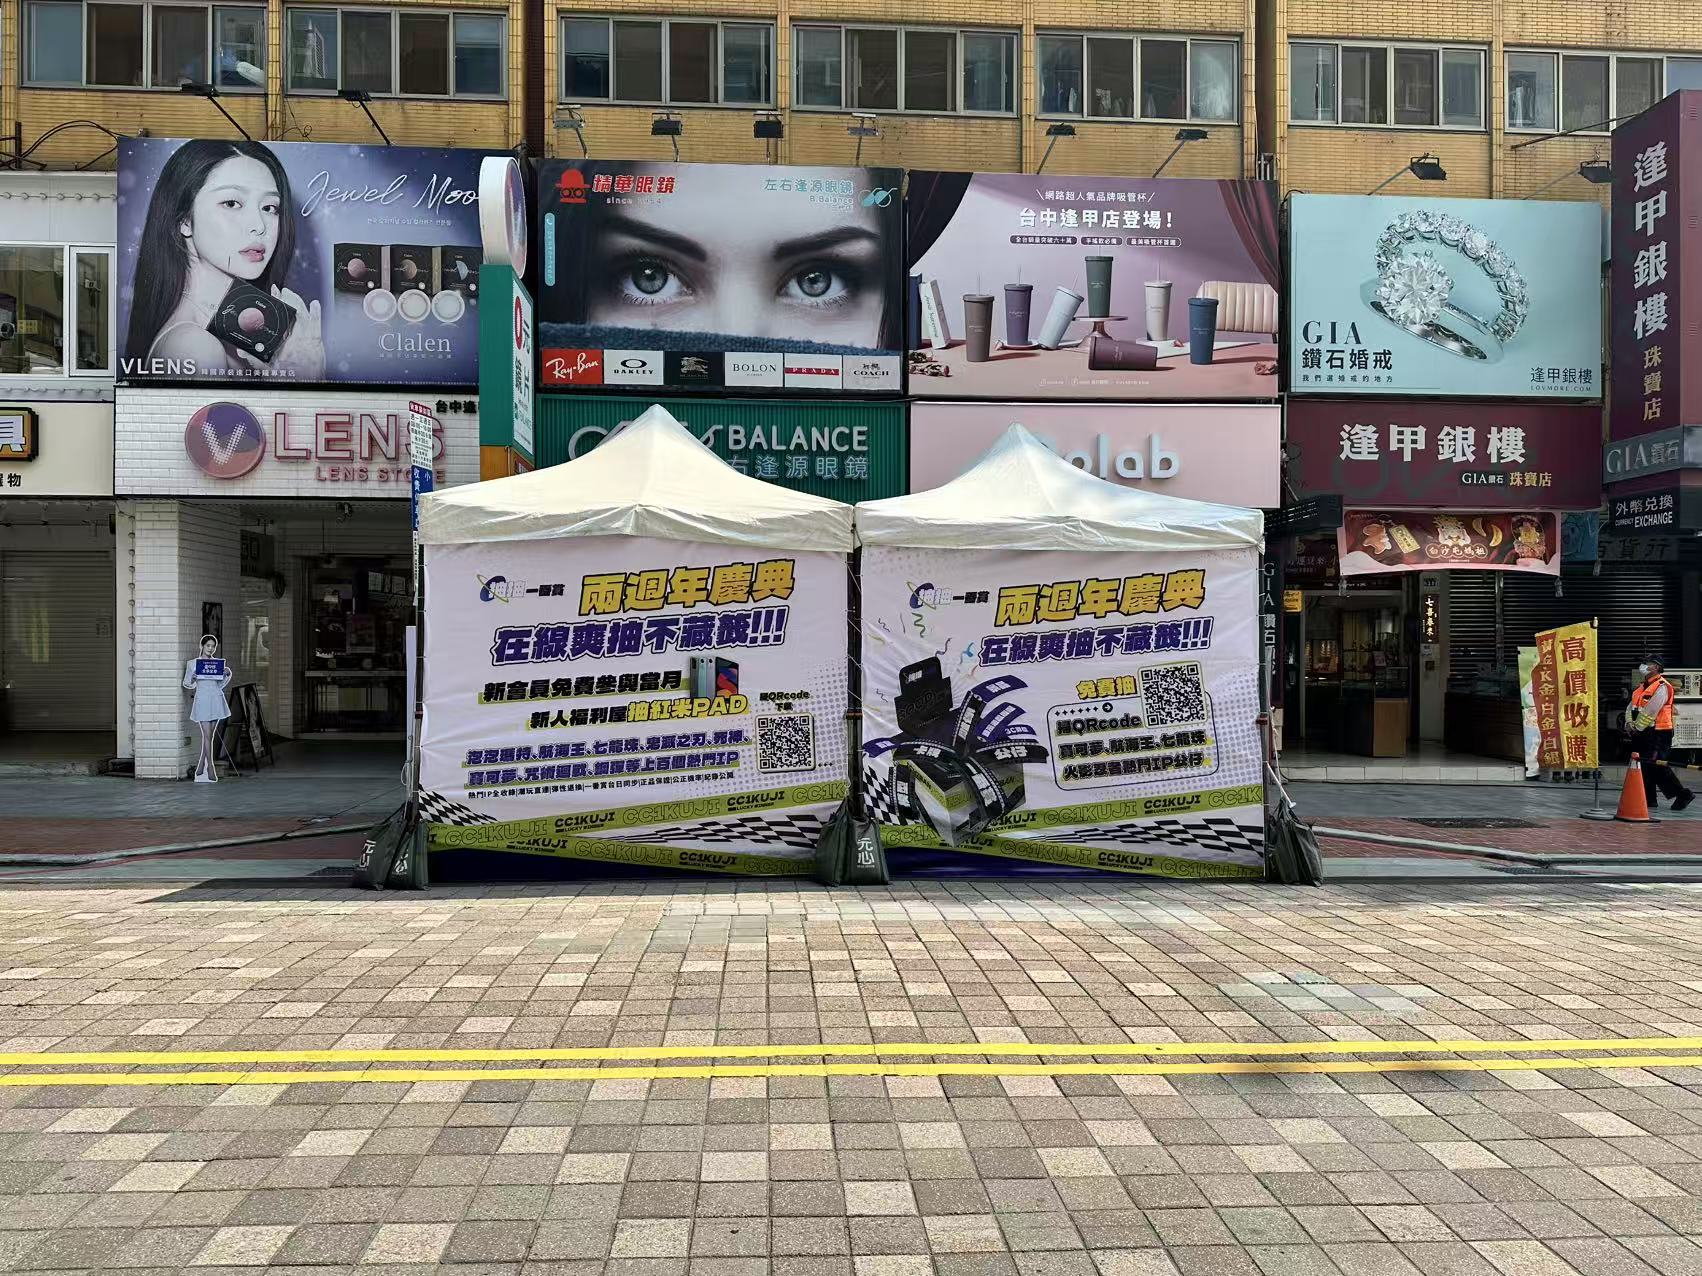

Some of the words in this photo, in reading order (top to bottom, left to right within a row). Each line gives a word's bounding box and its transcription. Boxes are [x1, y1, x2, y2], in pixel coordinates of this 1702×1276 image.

[301, 170, 407, 217] Jewel
[413, 173, 480, 215] Moo
[592, 174, 676, 194] 精華眼鏡
[763, 178, 854, 194] 左右逢源眼鏡
[1044, 190, 1148, 202] 網路超人氣品牌吸管杯
[1633, 140, 1669, 341] 逢甲銀樓
[379, 332, 452, 352] Clalen
[1302, 320, 1362, 344] GIA
[120, 357, 196, 375] VLENS
[733, 363, 777, 372] BOLON
[1302, 347, 1393, 370] 鑽石婚戒
[1530, 367, 1593, 385] 逢甲銀樓
[1643, 345, 1663, 422] 珠寶店
[201, 421, 248, 465] V
[728, 424, 868, 452] BALANCE
[1339, 423, 1527, 464] 逢甲銀樓
[315, 467, 369, 482] LENS
[377, 467, 446, 482] STOE
[1509, 471, 1552, 488] 珠寶店
[1615, 494, 1674, 516] 外幣兌換
[1634, 511, 1673, 528] EXCHANGE
[1427, 544, 1487, 558] 白沙屯媽祖
[578, 559, 795, 616] 兩週年慶典
[994, 569, 1207, 627] 兩週年慶典
[483, 669, 682, 702] 新會員免費參與當月
[1075, 674, 1138, 701] 免費抽
[1559, 636, 1590, 764] 高價收購
[727, 790, 785, 807] CC1KUJI
[1144, 795, 1201, 810] CC1KUJI
[554, 811, 616, 828] CC1KUJI
[622, 799, 720, 825] CC1KUJI
[1043, 801, 1138, 825] CC1KUJI
[444, 819, 549, 847] CC1KUJI
[507, 837, 569, 849] 1KUJI
[679, 851, 737, 866] CC1KUJI
[856, 837, 875, 864] 元心
[1098, 851, 1154, 867] CC1KUJI
